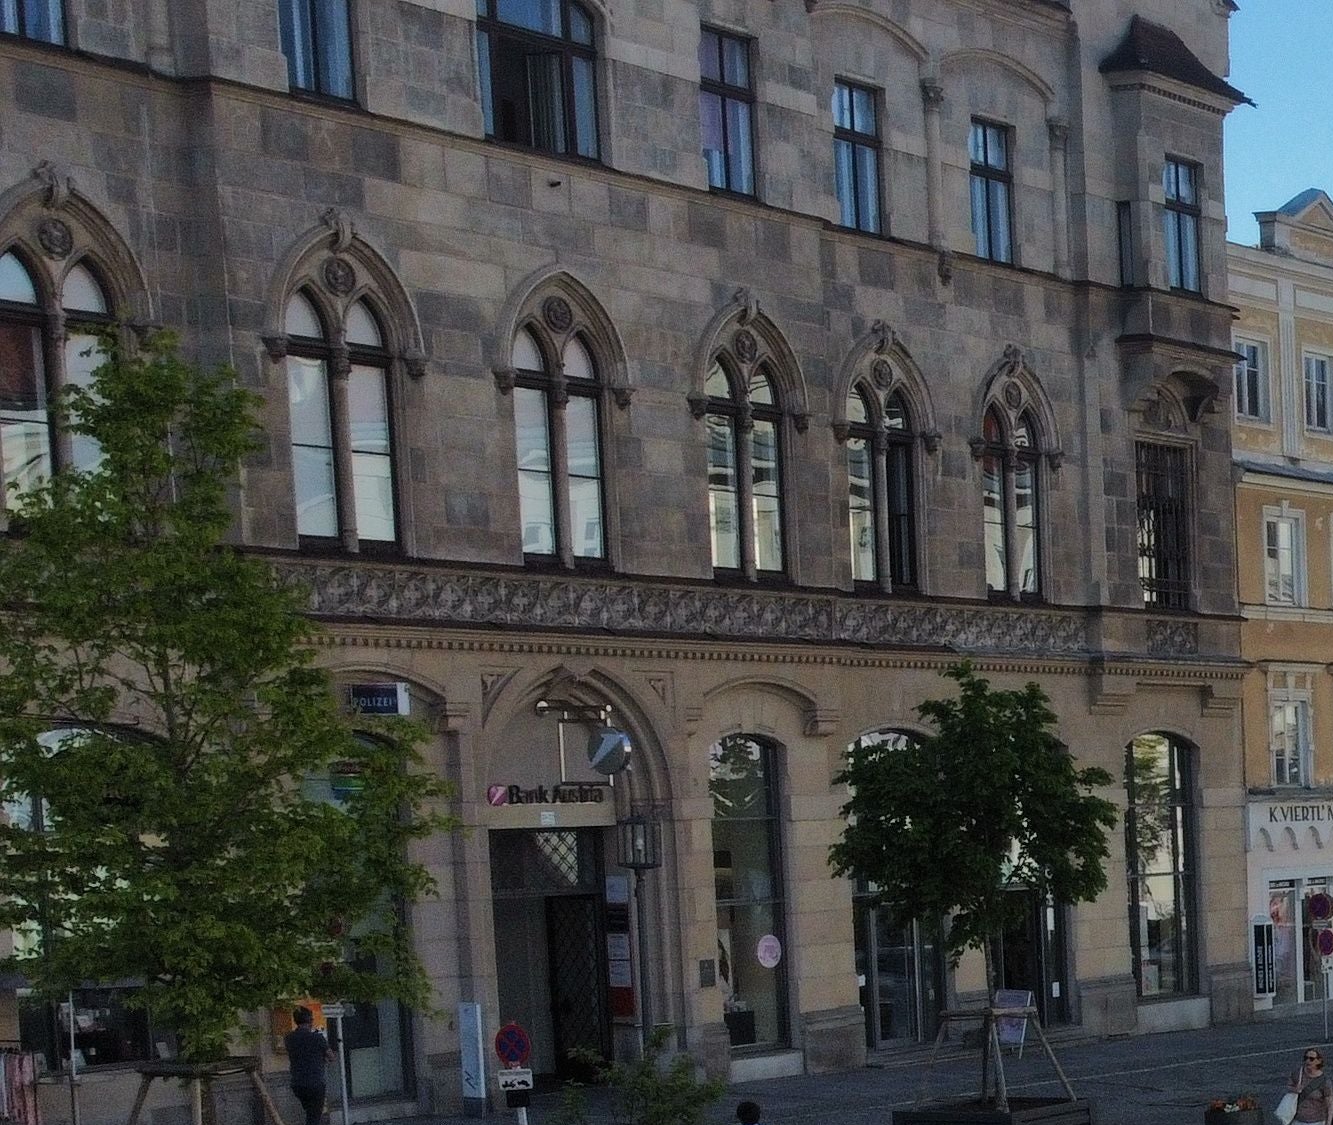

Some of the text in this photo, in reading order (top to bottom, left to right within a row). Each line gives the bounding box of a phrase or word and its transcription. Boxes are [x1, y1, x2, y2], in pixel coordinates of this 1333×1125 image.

[352, 697, 392, 708] POLIZEI
[508, 784, 602, 804] Bank Austria
